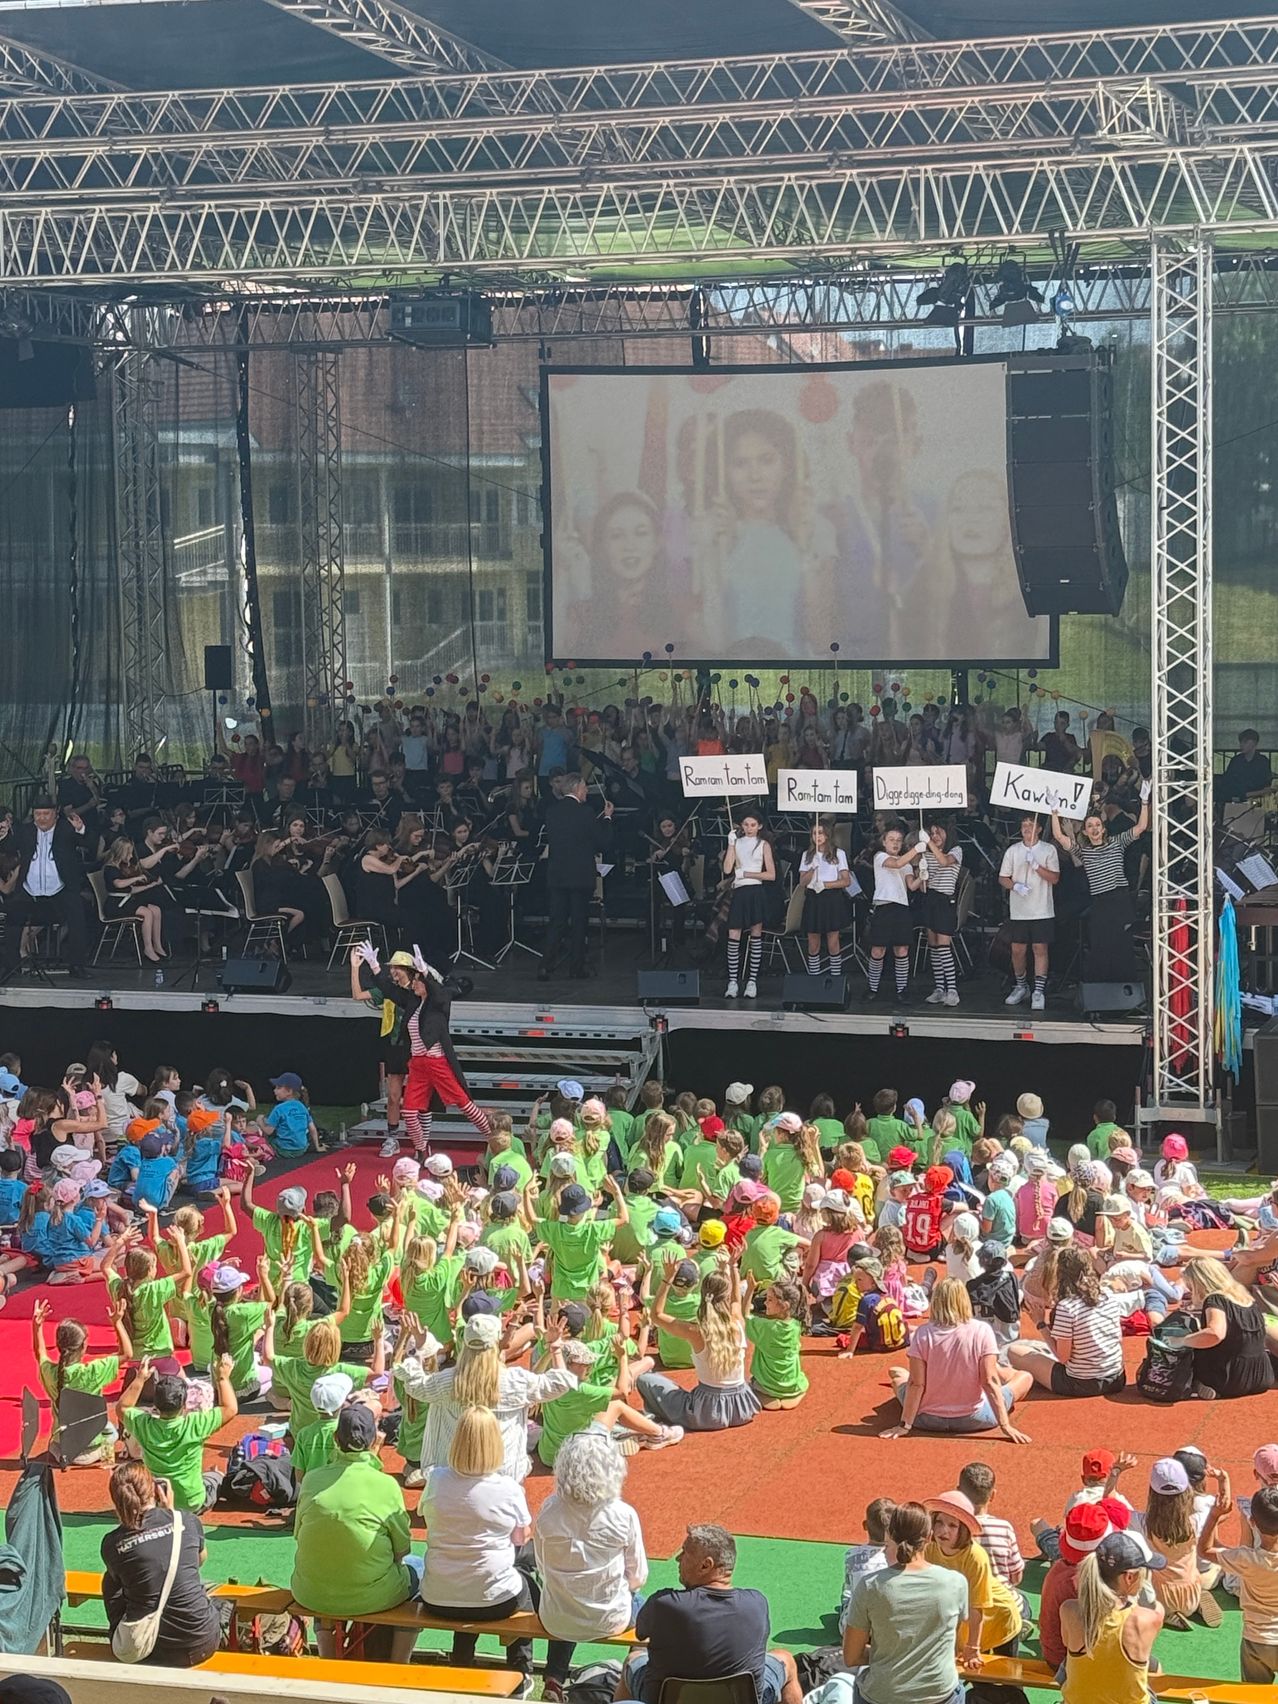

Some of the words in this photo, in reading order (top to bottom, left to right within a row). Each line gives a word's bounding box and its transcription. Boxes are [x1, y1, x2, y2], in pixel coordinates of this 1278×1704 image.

[906, 1211, 931, 1245] 19
[878, 1308, 906, 1345] 10
[117, 1525, 185, 1555] MATTERSBU
